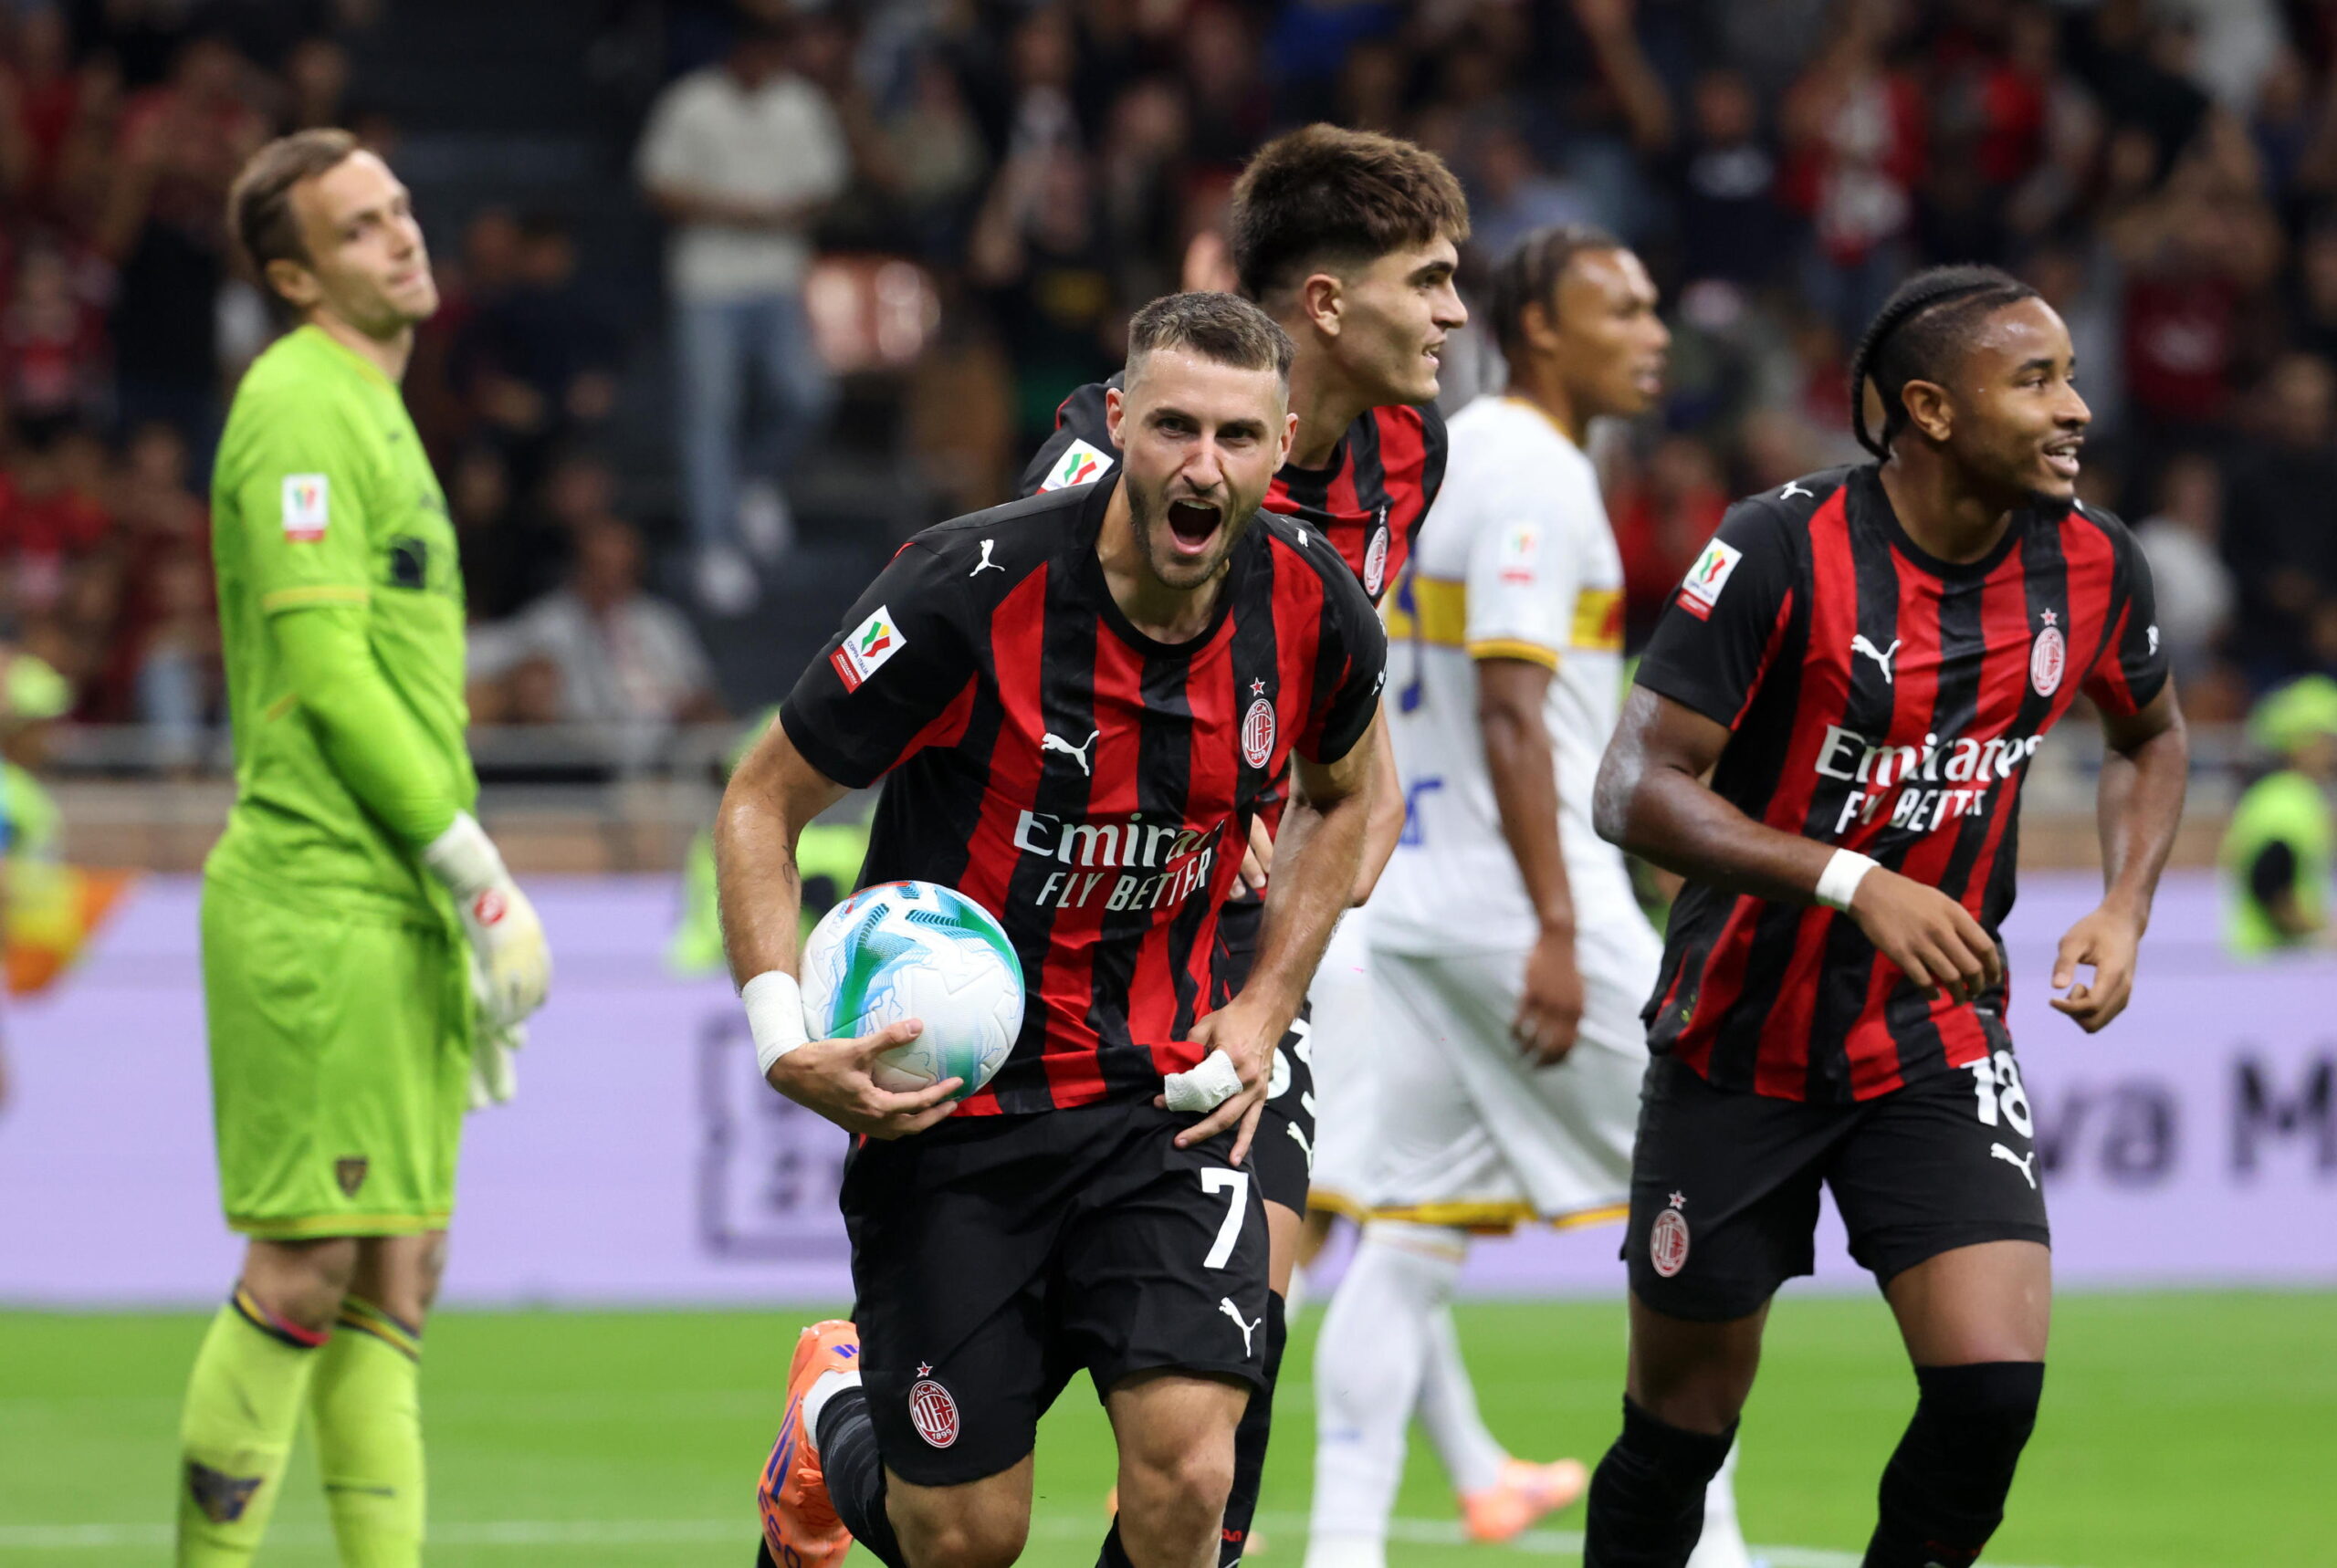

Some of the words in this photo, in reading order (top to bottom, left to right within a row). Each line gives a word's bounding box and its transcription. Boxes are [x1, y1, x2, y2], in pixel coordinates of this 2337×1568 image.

[847, 640, 859, 659] COPPA
[858, 657, 869, 675] ITALIA
[1035, 872, 1106, 909] FLY
[1105, 847, 1212, 912] BETTER
[1959, 1050, 2035, 1139] 18
[1200, 1166, 1249, 1270] 7
[916, 1385, 940, 1401] ACM
[931, 1428, 953, 1440] 1899
